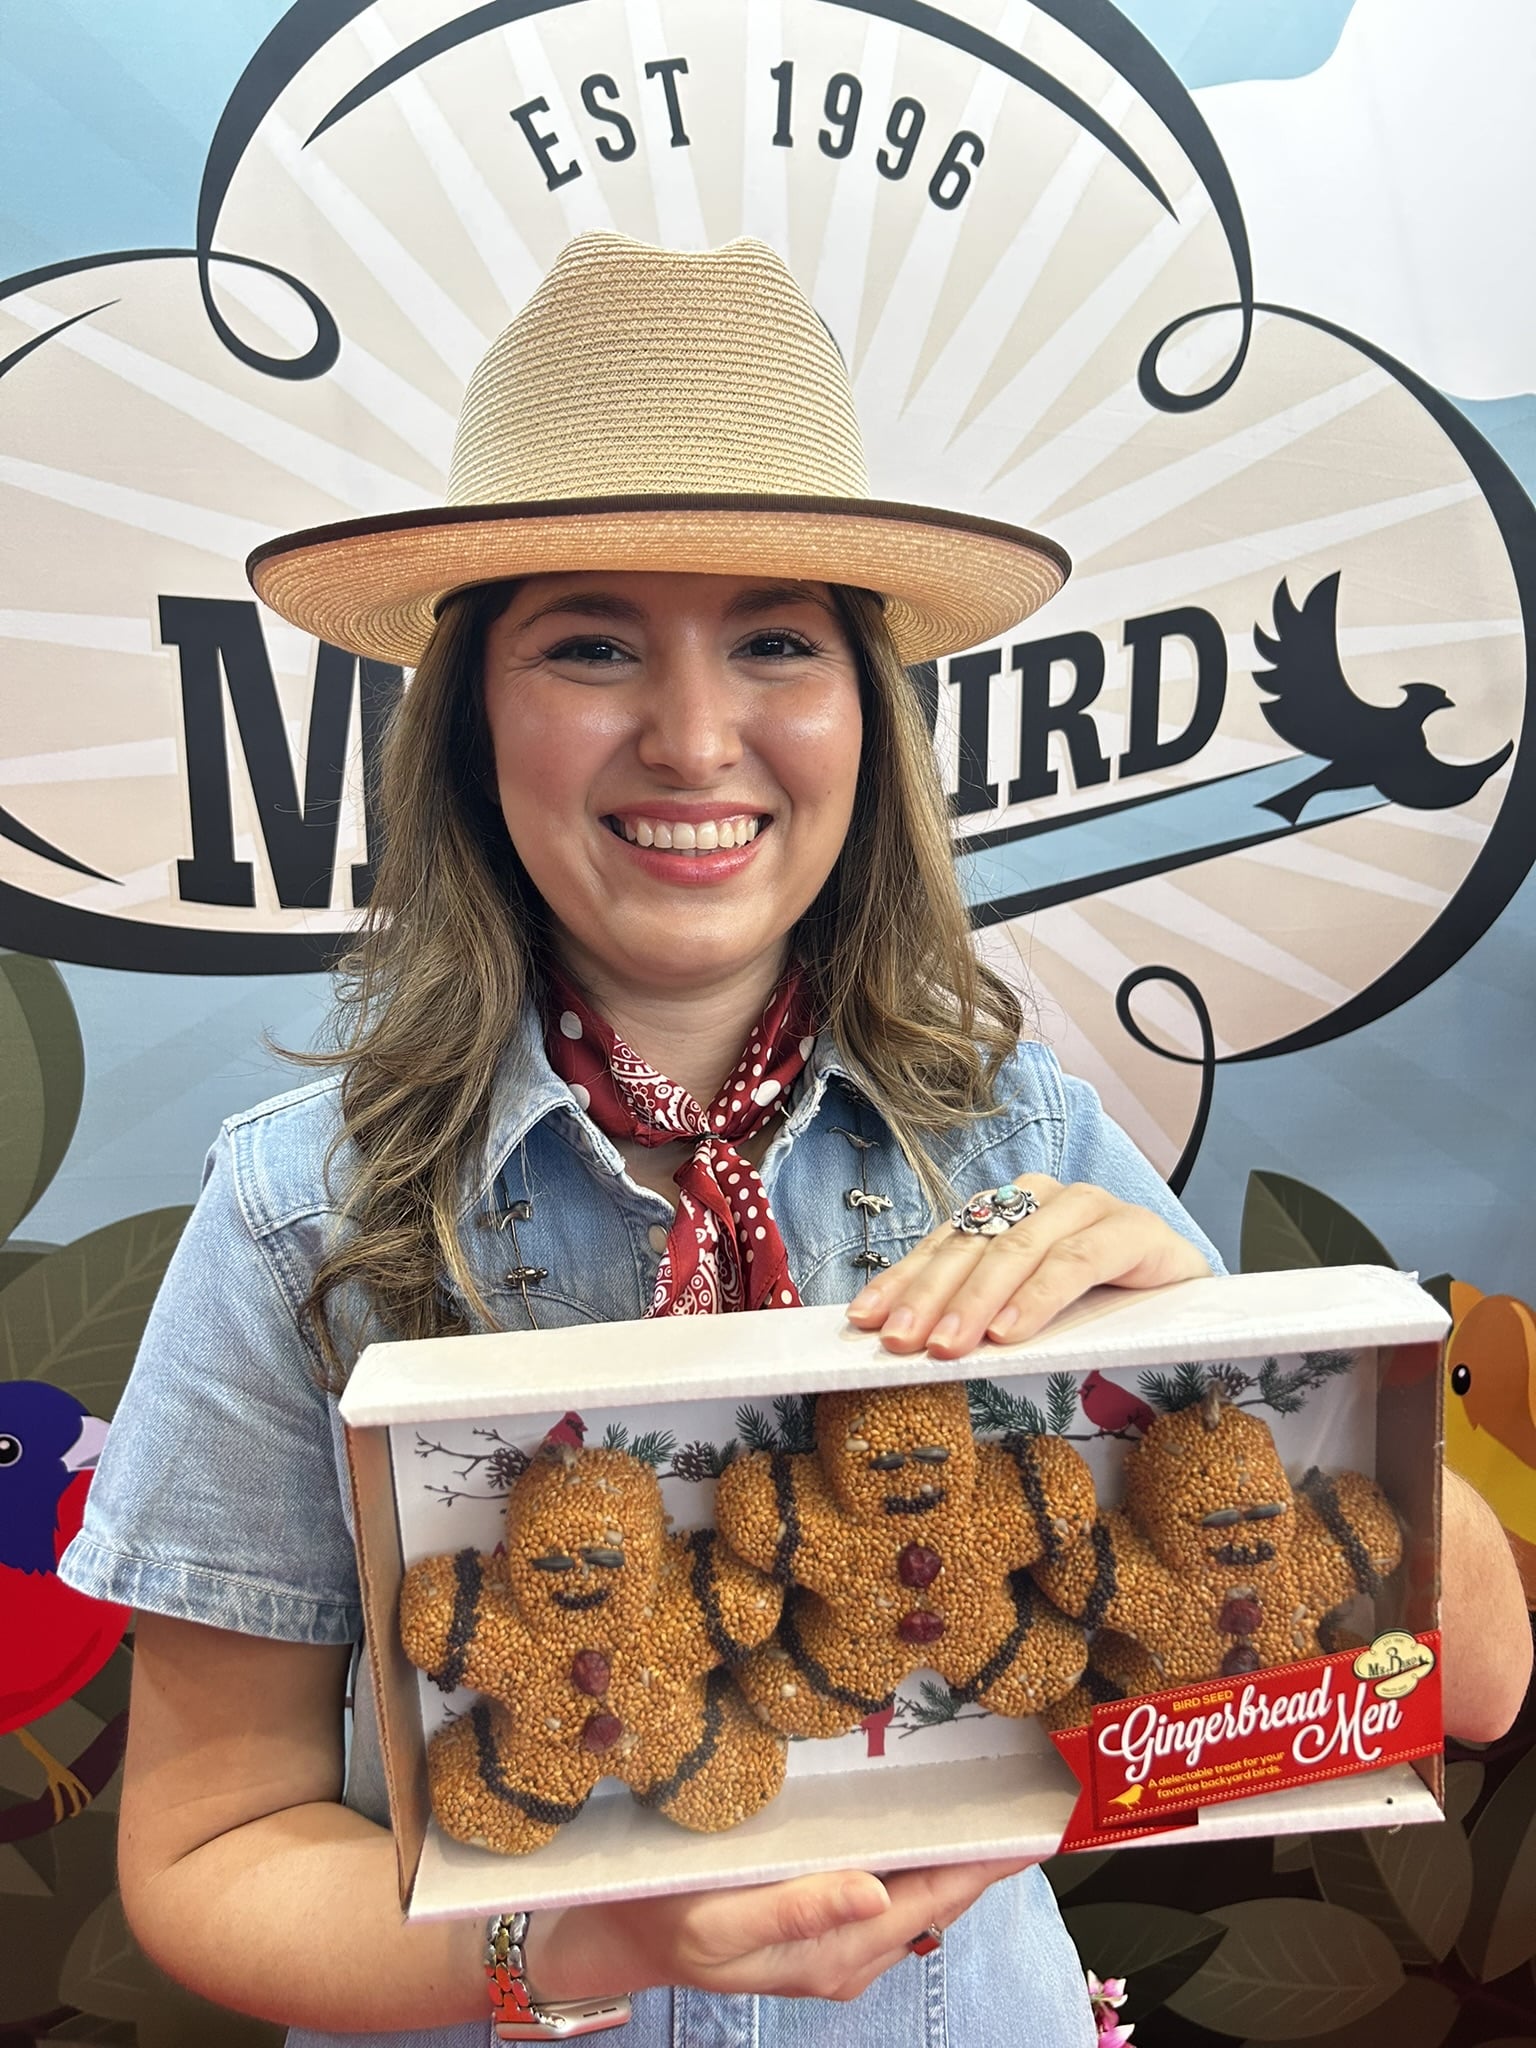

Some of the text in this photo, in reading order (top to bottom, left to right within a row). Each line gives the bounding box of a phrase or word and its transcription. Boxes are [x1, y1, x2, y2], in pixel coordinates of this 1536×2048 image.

[509, 57, 986, 211] EST 1996
[904, 606, 1229, 818] IRD
[1098, 1666, 1332, 1783] Gingerbread
[1172, 1690, 1234, 1712] BIRD SEED
[1292, 1682, 1403, 1764] Men
[1148, 1751, 1285, 1789] A delectable treat for your
[1157, 1764, 1282, 1798] favorite backyard birds.
